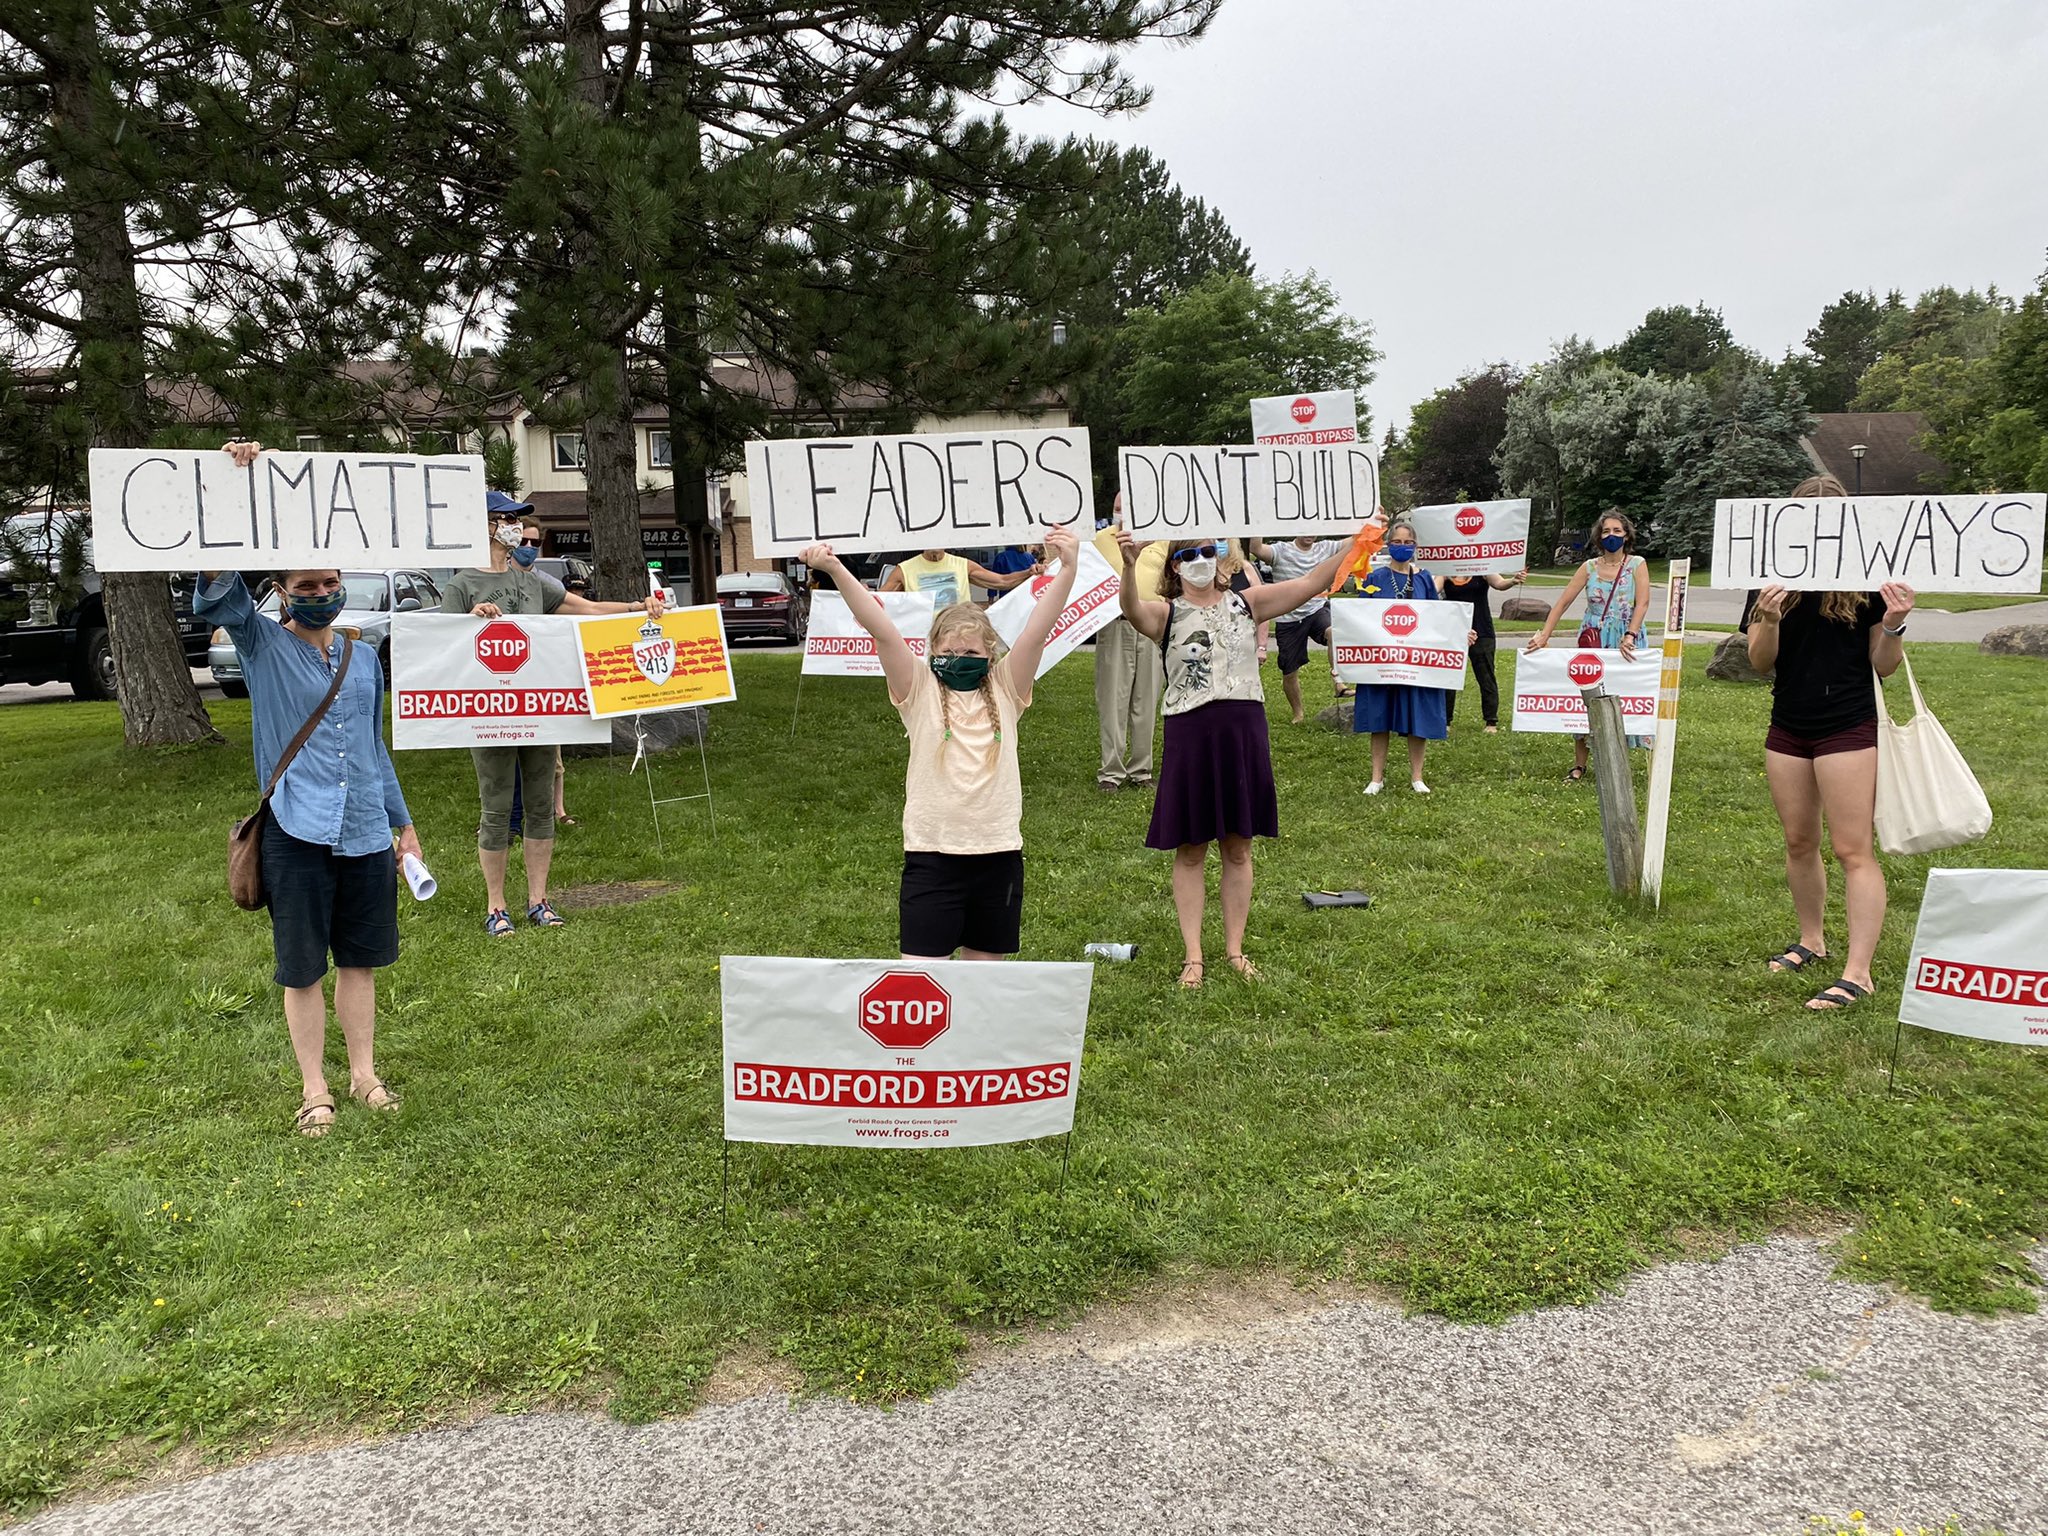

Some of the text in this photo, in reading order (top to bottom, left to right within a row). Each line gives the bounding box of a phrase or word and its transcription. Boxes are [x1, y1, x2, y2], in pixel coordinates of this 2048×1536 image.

[1292, 405, 1316, 416] STOP
[1316, 429, 1354, 443] BYPASS
[765, 436, 1083, 542] LEADERS
[1125, 448, 1376, 530] DON'T BUILD
[121, 457, 472, 550] CLIMATE
[1457, 516, 1483, 528] STOP
[556, 533, 580, 544] THE
[643, 531, 668, 542] BAR
[672, 531, 680, 540] &
[1728, 499, 2033, 579] HIGHWAYS
[1417, 541, 1524, 560] BRADFORD BYPASS
[1077, 577, 1120, 612] BYPASS
[1385, 614, 1416, 627] STOP
[479, 640, 527, 657] STOP
[636, 640, 671, 664] STOP
[808, 639, 872, 654] BRADFORD
[646, 656, 668, 675] 413
[1337, 647, 1464, 668] BRADFORD BYPASS
[1570, 664, 1602, 676] STOP
[400, 692, 589, 716] BRADFORD BYPAS
[1518, 697, 1588, 712] BRADFOR
[476, 730, 535, 740] www.frogs.ca
[1918, 962, 2048, 1003] BRADFO
[866, 1000, 944, 1025] STOP
[895, 1057, 916, 1066] THE
[736, 1067, 1067, 1104] BRADFORD BYPASS
[856, 1128, 950, 1140] www.frogs.ca
